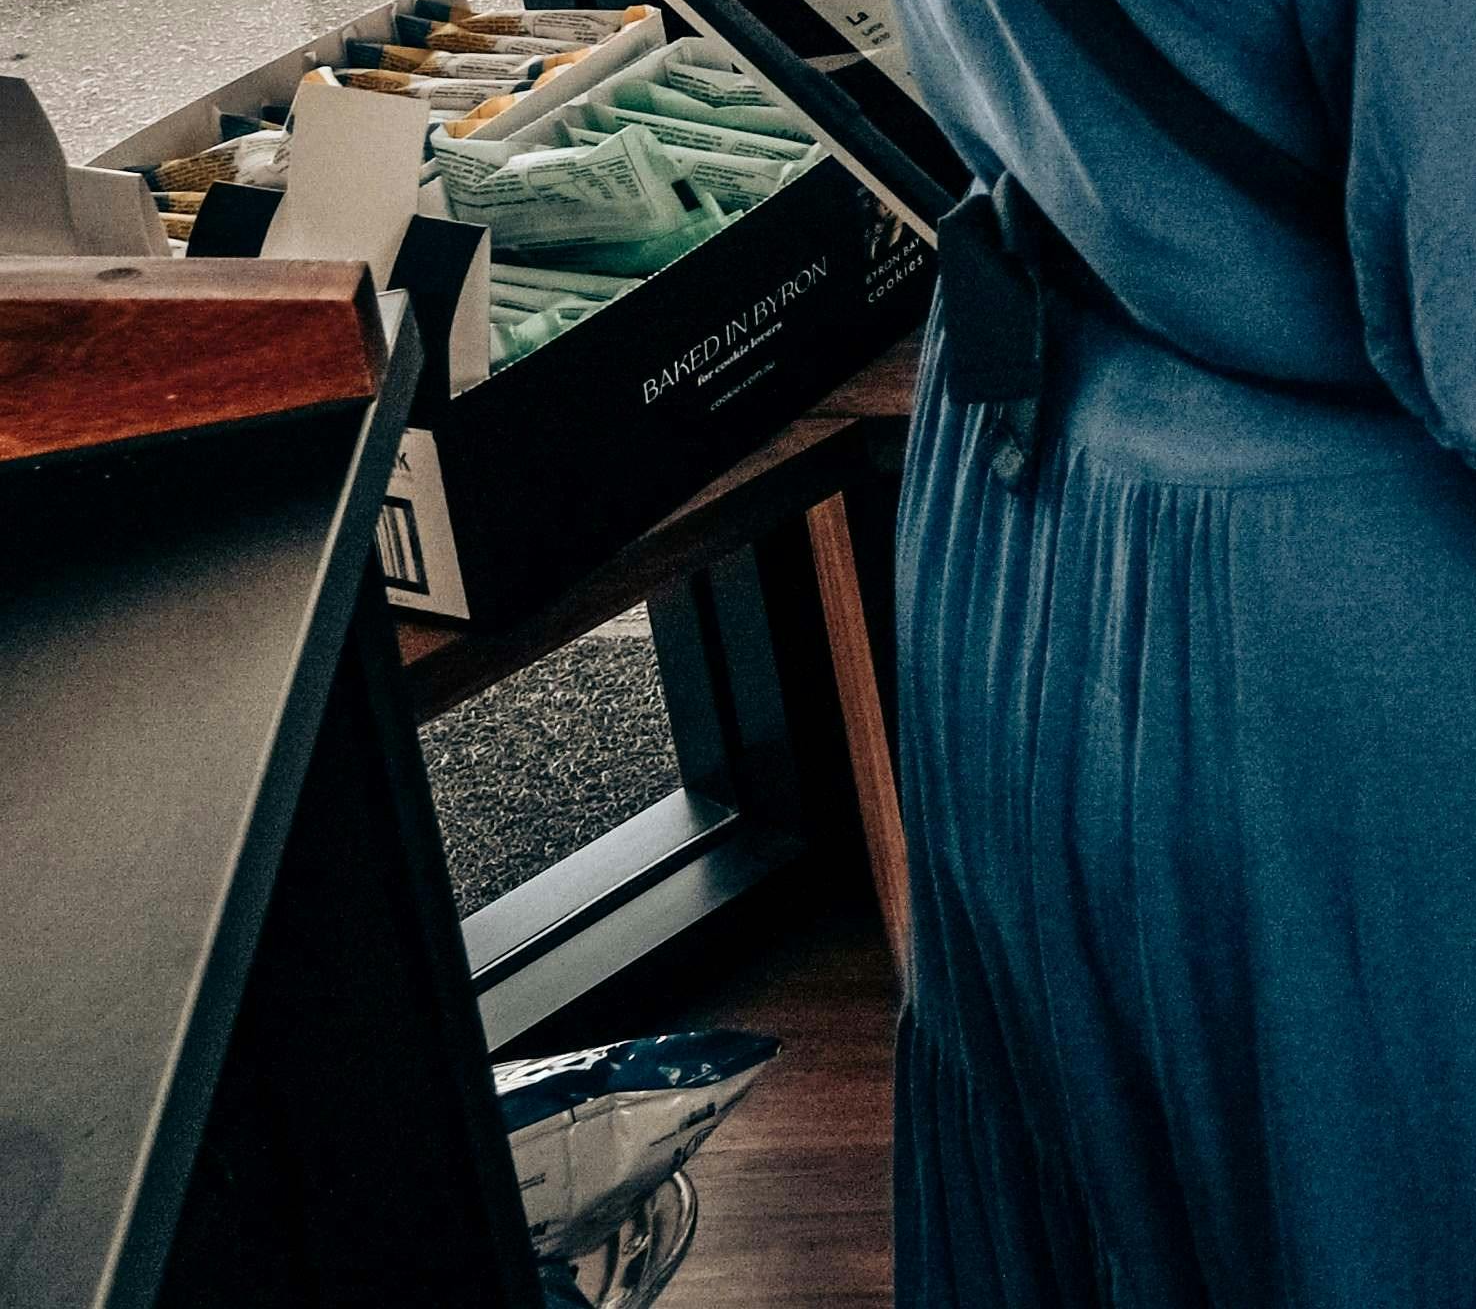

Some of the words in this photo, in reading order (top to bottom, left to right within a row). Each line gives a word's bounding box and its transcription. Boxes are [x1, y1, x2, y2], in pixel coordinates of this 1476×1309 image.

[846, 11, 869, 26] La
[866, 254, 900, 285] BYRON
[903, 237, 921, 257] BAY
[642, 335, 720, 404] BAKED
[726, 312, 749, 346] IN
[752, 255, 828, 326] BYRON
[697, 369, 715, 387] for
[714, 343, 750, 374] cookie
[750, 320, 783, 350] lovers
